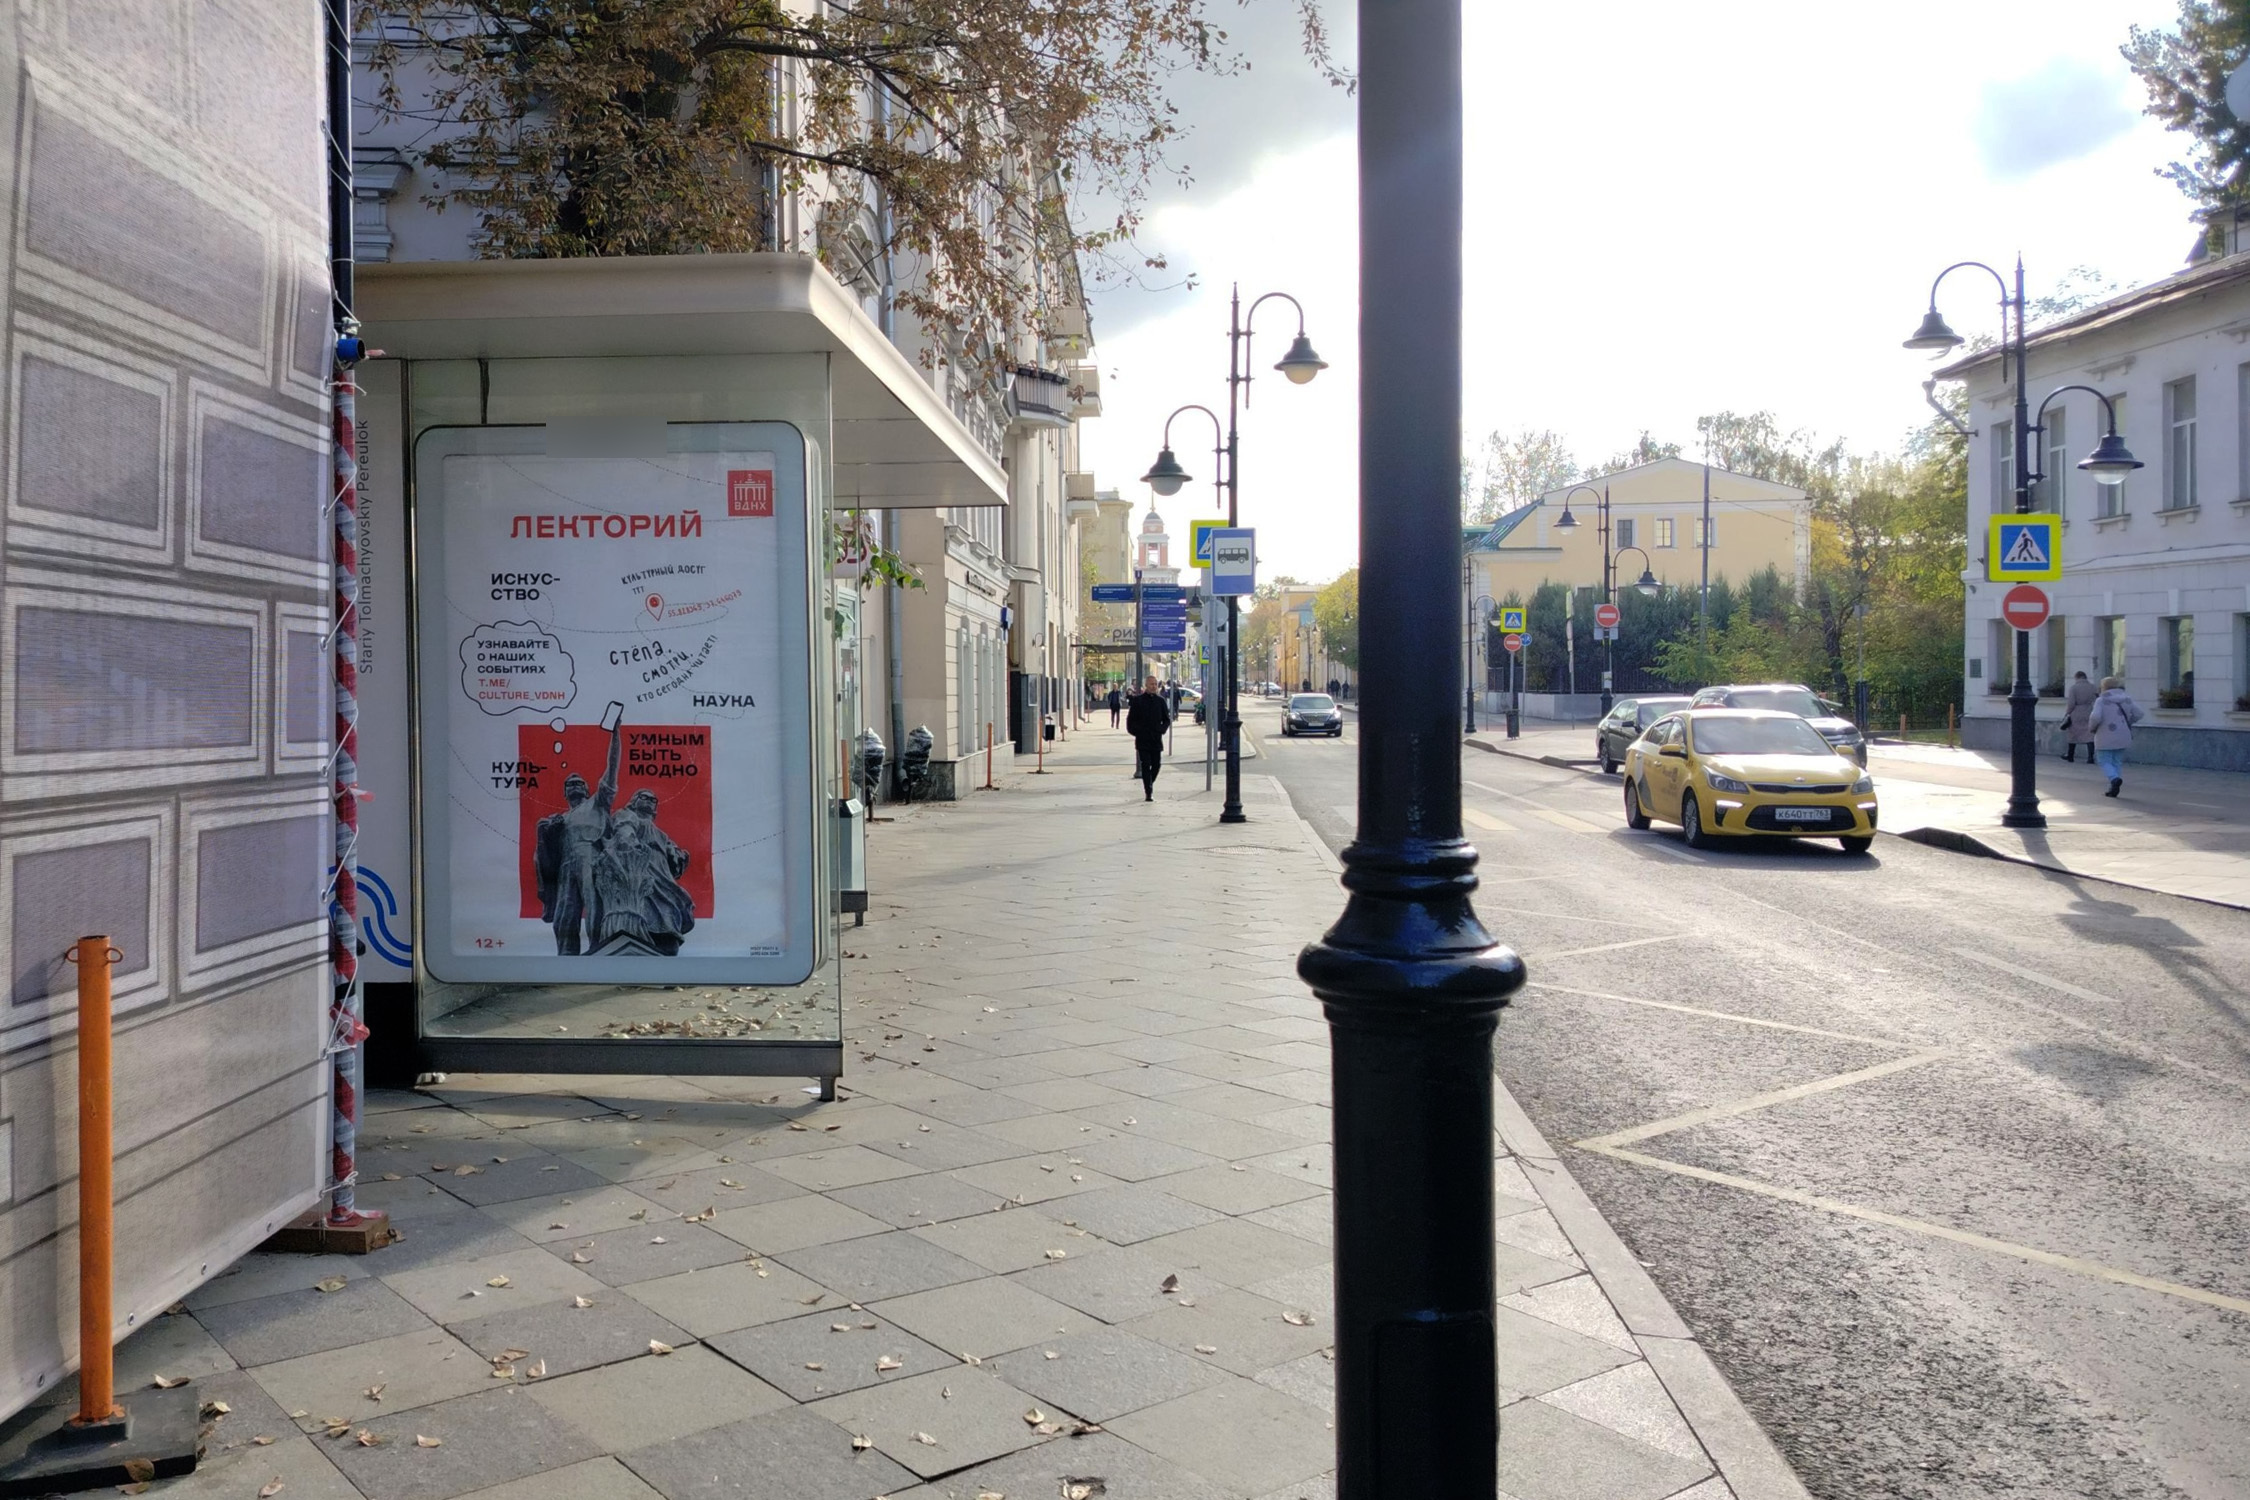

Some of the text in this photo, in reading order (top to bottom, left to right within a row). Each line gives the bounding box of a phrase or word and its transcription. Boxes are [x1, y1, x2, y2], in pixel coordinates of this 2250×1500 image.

[734, 501, 767, 511] ВДНХ
[510, 509, 702, 538] ЛЕКТОРИЙ
[356, 419, 375, 674] Stariy Tolmachyovskiy Pereulok
[491, 573, 561, 585] ИСКУС-
[491, 588, 540, 601] СТВО
[477, 639, 550, 649] УЗНАВАЙТЕ
[477, 653, 535, 662] О НАШИХ
[477, 665, 546, 674] СОБЫТИЯХ
[478, 679, 511, 688] T.ME/
[478, 691, 565, 701] CULTURE_VDNH
[693, 695, 755, 708] НАУКА
[629, 734, 704, 746] УМНЫМ
[629, 749, 682, 761] БЫТЬ
[491, 761, 548, 774] КУЛЬ-
[629, 765, 698, 778] МОДНО
[491, 777, 539, 789] ТУРА
[475, 938, 505, 949] 12+
